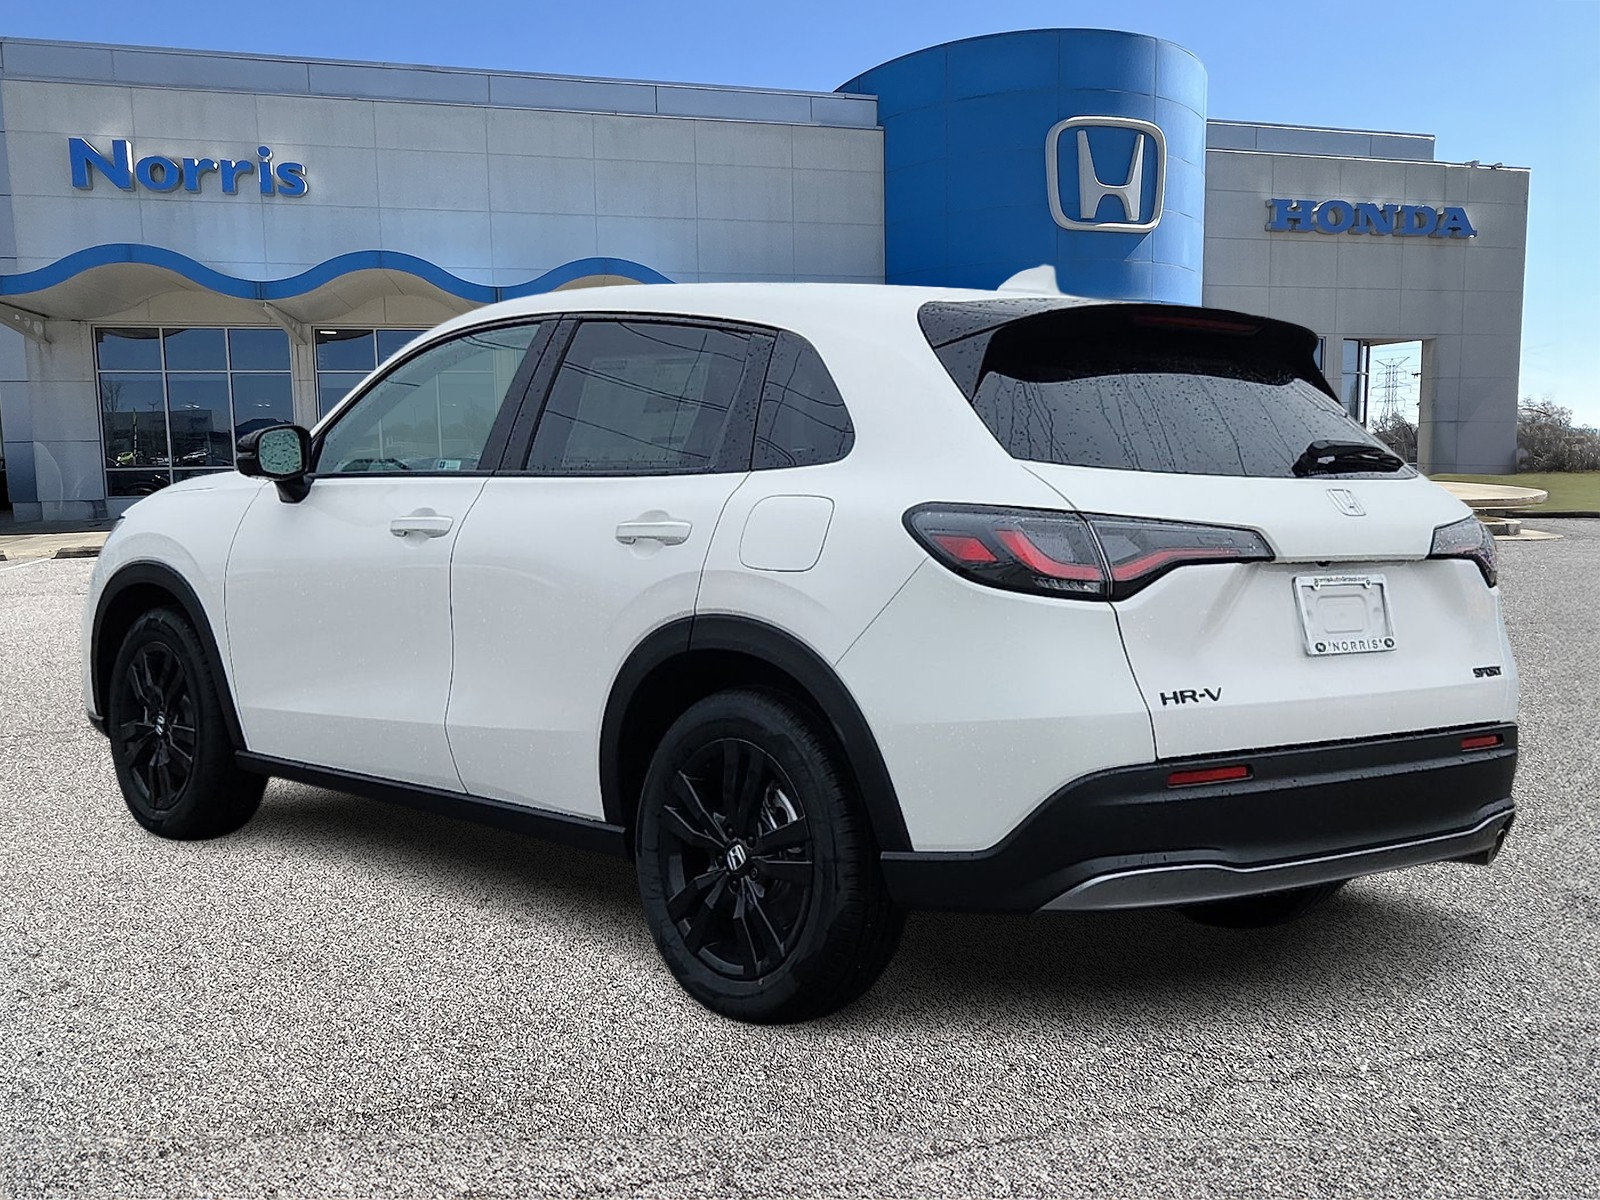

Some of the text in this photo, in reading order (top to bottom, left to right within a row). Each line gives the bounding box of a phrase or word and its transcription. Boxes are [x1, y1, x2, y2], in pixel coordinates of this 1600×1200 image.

[68, 137, 309, 198] Norris
[1265, 198, 1478, 239] HONDA
[1160, 687, 1222, 706] HR-V
